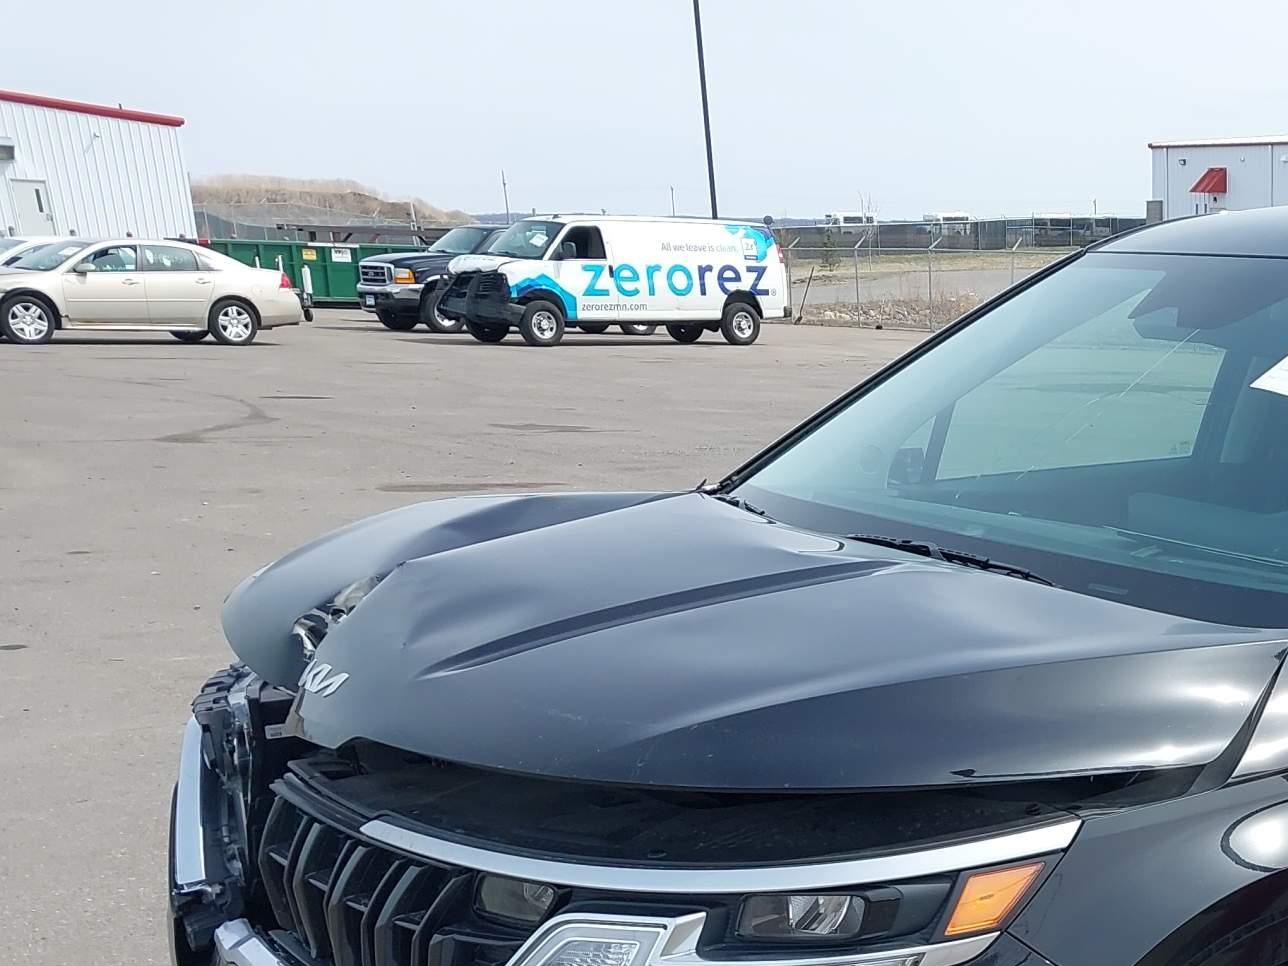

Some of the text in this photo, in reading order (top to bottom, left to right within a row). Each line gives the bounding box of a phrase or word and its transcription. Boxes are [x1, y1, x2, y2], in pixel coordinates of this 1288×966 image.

[661, 242, 672, 252] All
[673, 244, 685, 252] we
[686, 242, 707, 252] leave
[708, 242, 715, 252] is
[582, 303, 648, 312] zerorezmn.com
